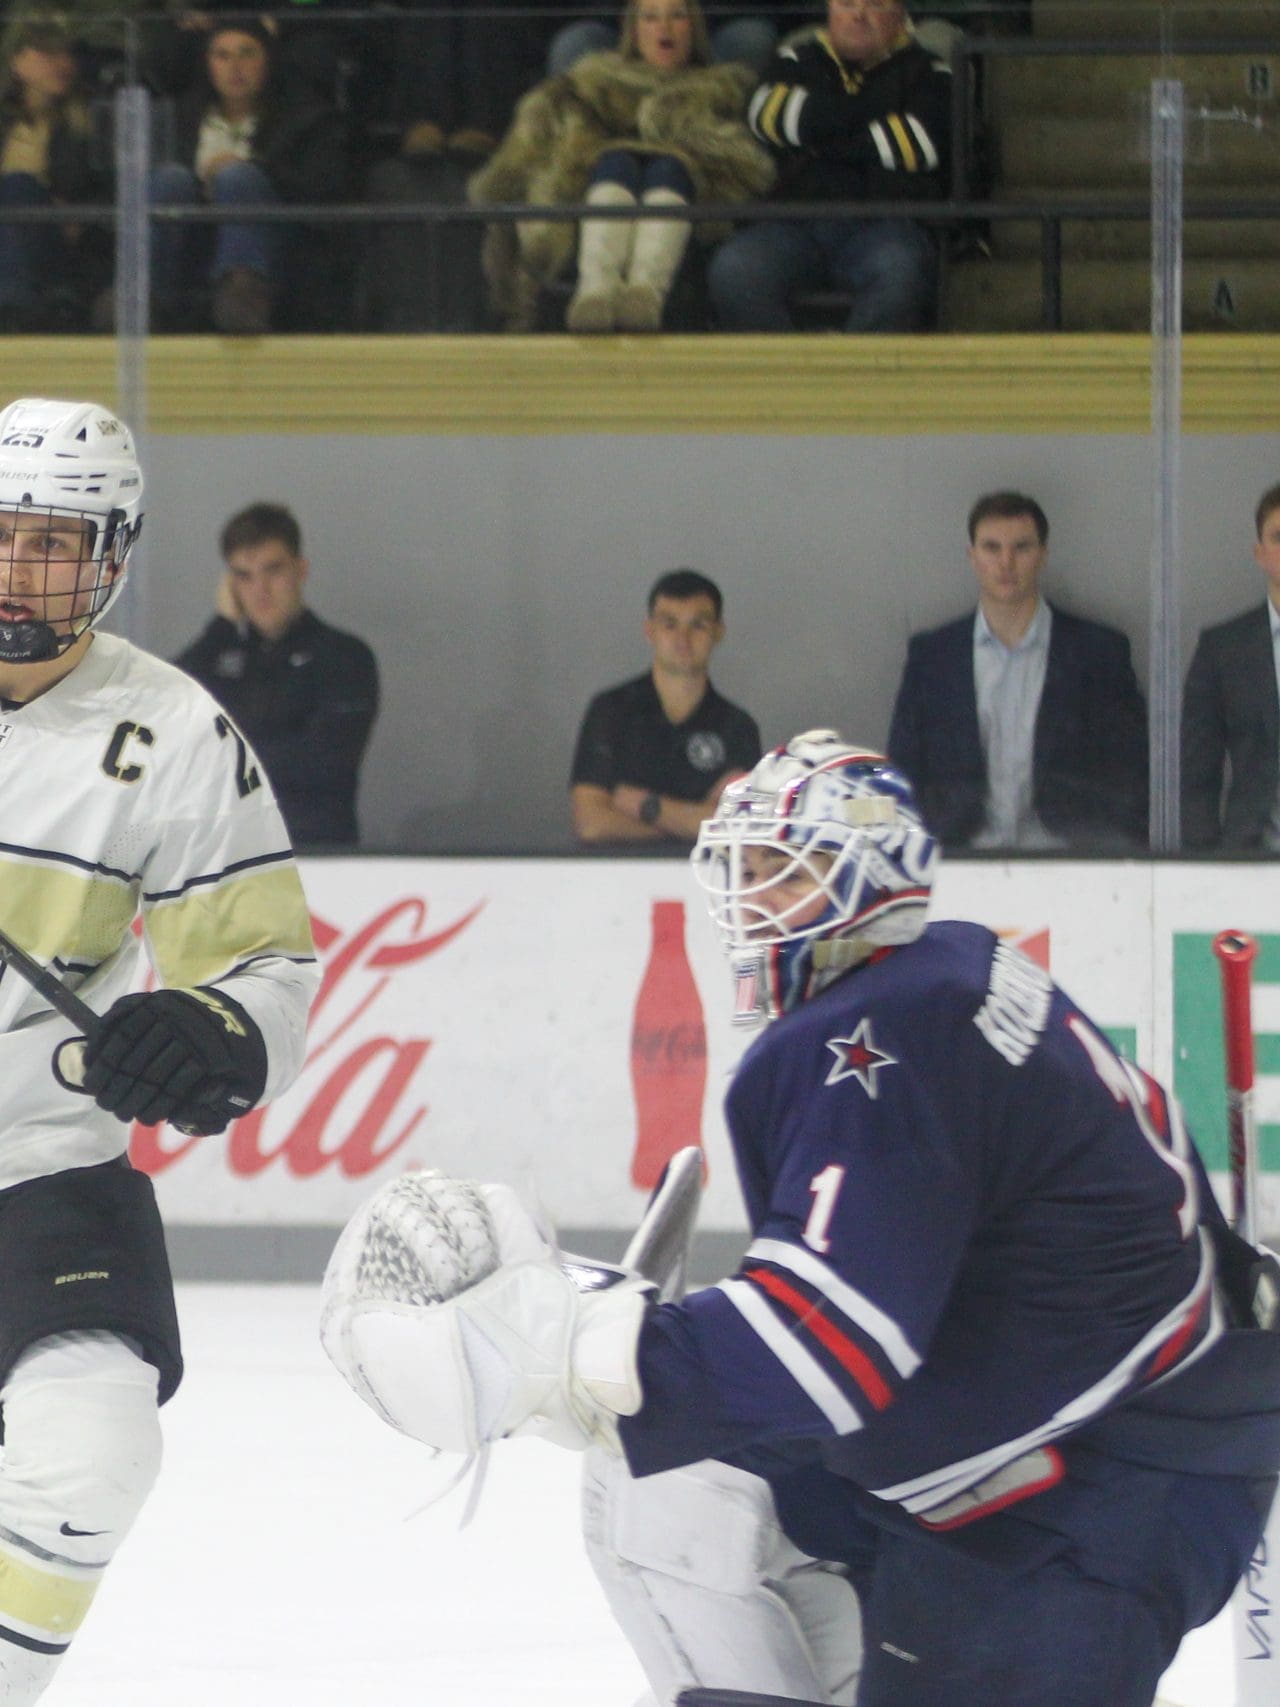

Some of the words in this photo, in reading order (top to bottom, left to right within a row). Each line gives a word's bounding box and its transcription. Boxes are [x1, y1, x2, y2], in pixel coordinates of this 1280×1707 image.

[101, 720, 156, 785] C
[800, 1164, 846, 1255] 1
[54, 1270, 110, 1286] BAUER
